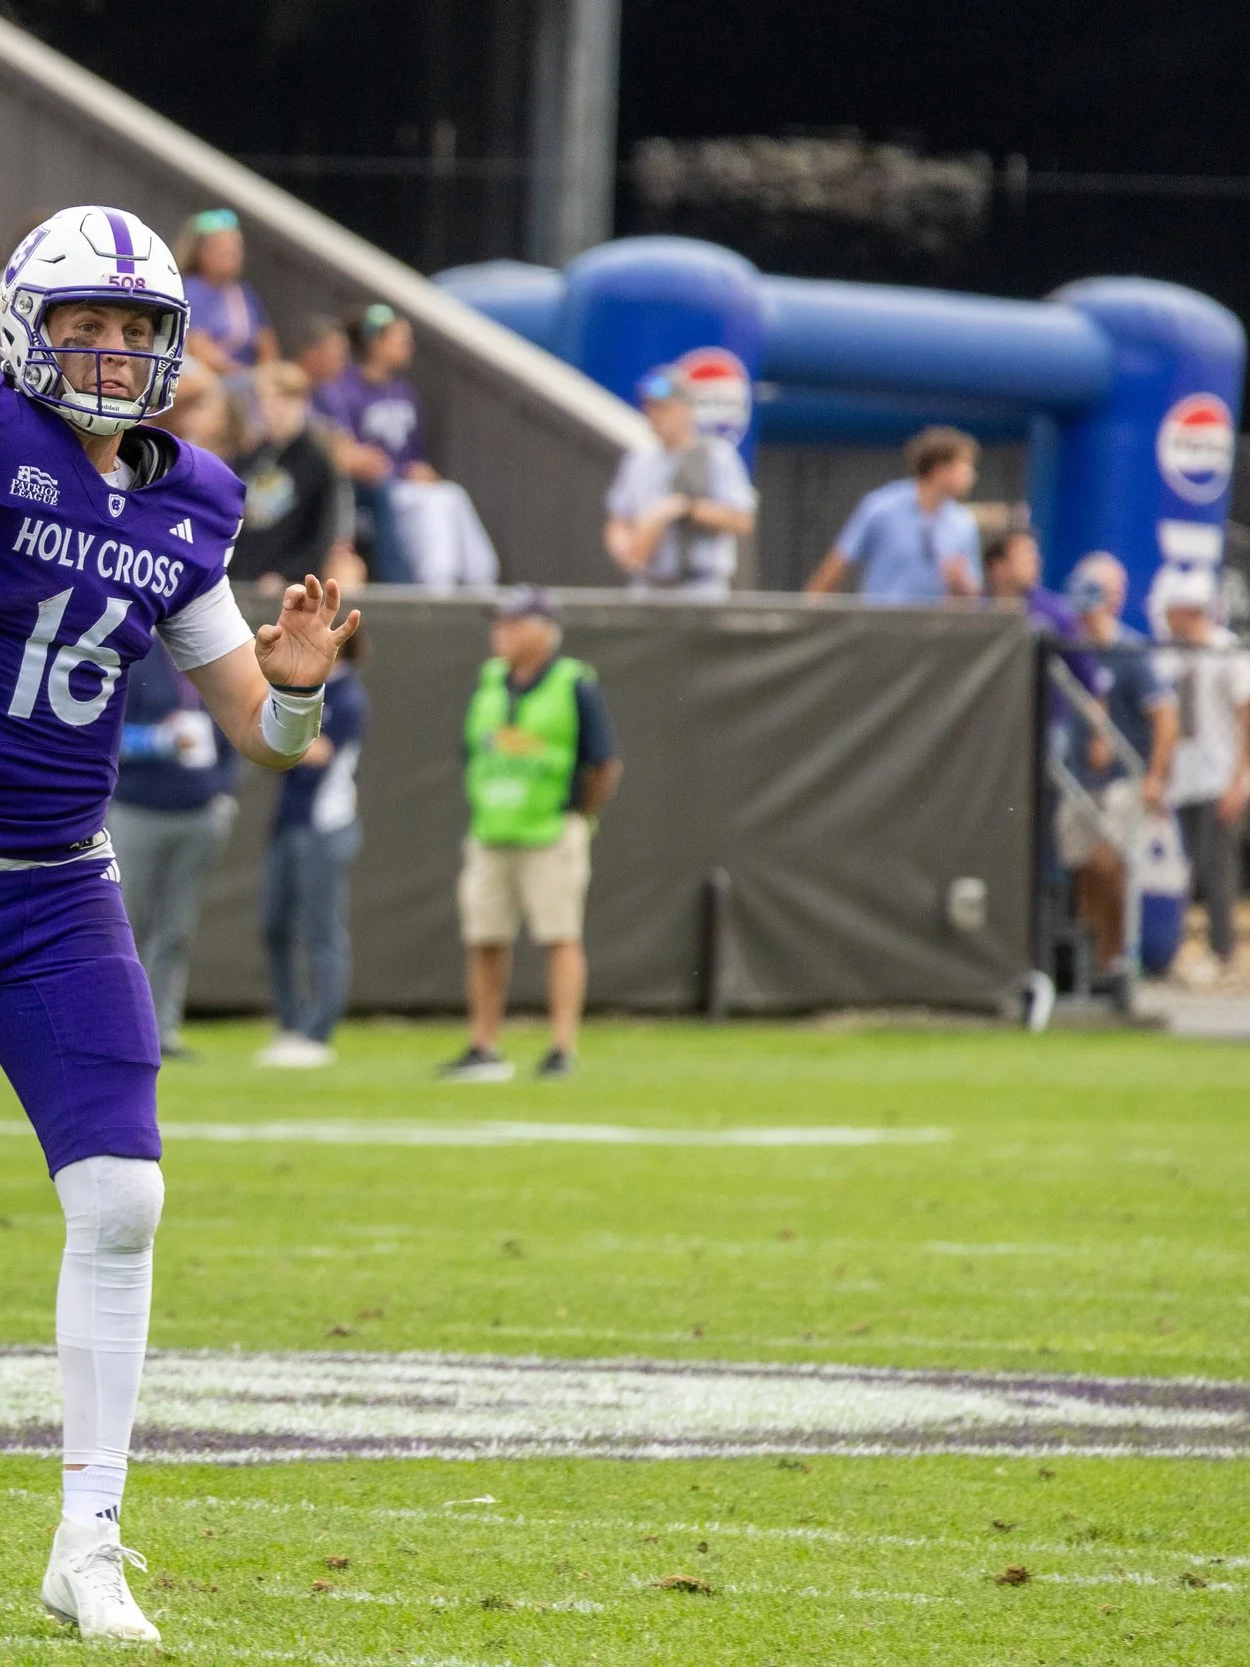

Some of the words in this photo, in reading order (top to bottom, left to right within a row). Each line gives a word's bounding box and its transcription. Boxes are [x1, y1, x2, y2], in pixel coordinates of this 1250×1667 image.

[108, 275, 147, 288] 508
[10, 478, 60, 498] PATRIOT
[10, 486, 58, 506] LEAGUE
[12, 517, 95, 571] HOLY
[97, 540, 184, 597] CROSS
[8, 587, 133, 726] 16
